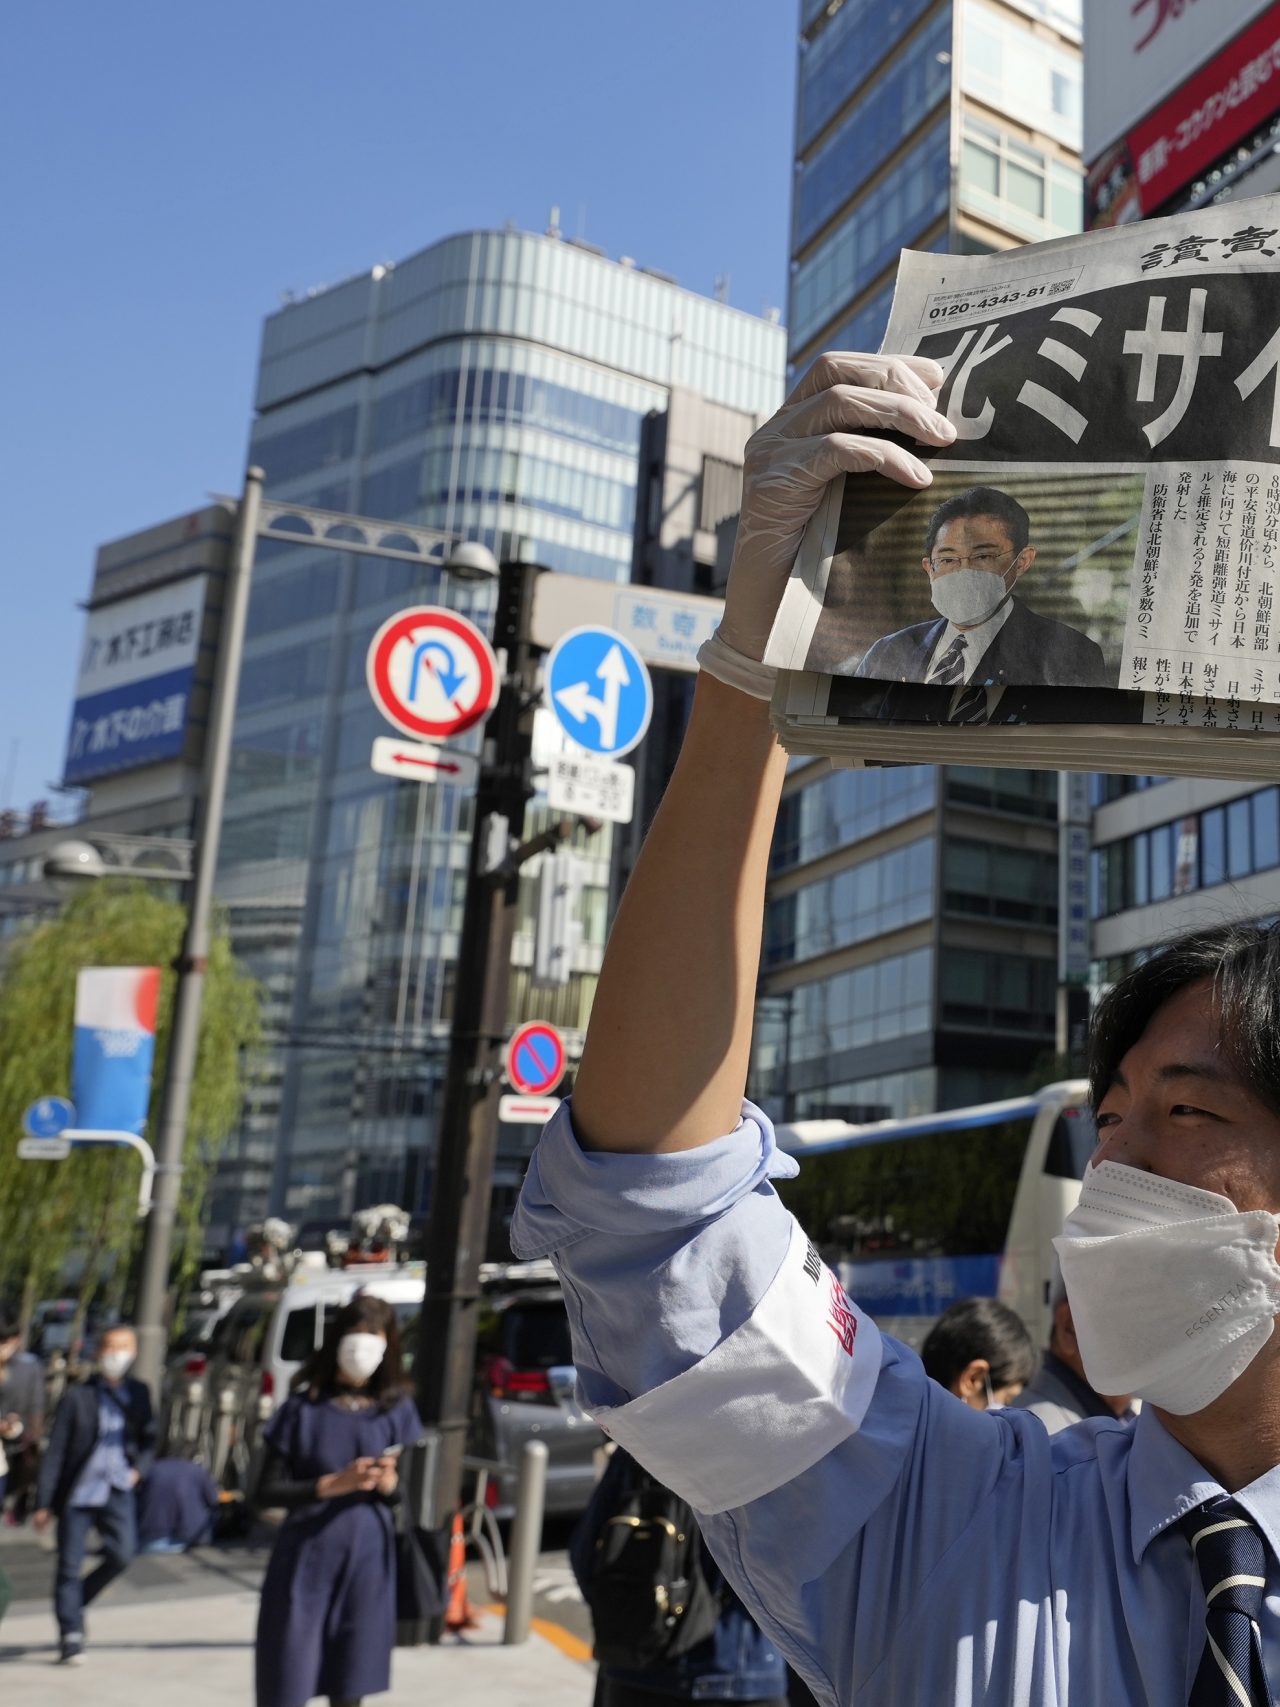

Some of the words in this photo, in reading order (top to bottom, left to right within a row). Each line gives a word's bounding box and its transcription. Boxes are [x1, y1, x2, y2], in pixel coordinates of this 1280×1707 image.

[929, 285, 1046, 319] 0120-4343-81
[1137, 483, 1168, 640] 防衛省は北朝鮮が多数のミ
[1184, 471, 1215, 644] ルと推定される2発を追加で
[1208, 470, 1238, 647] 海に向けて短距離弾道ミサイ
